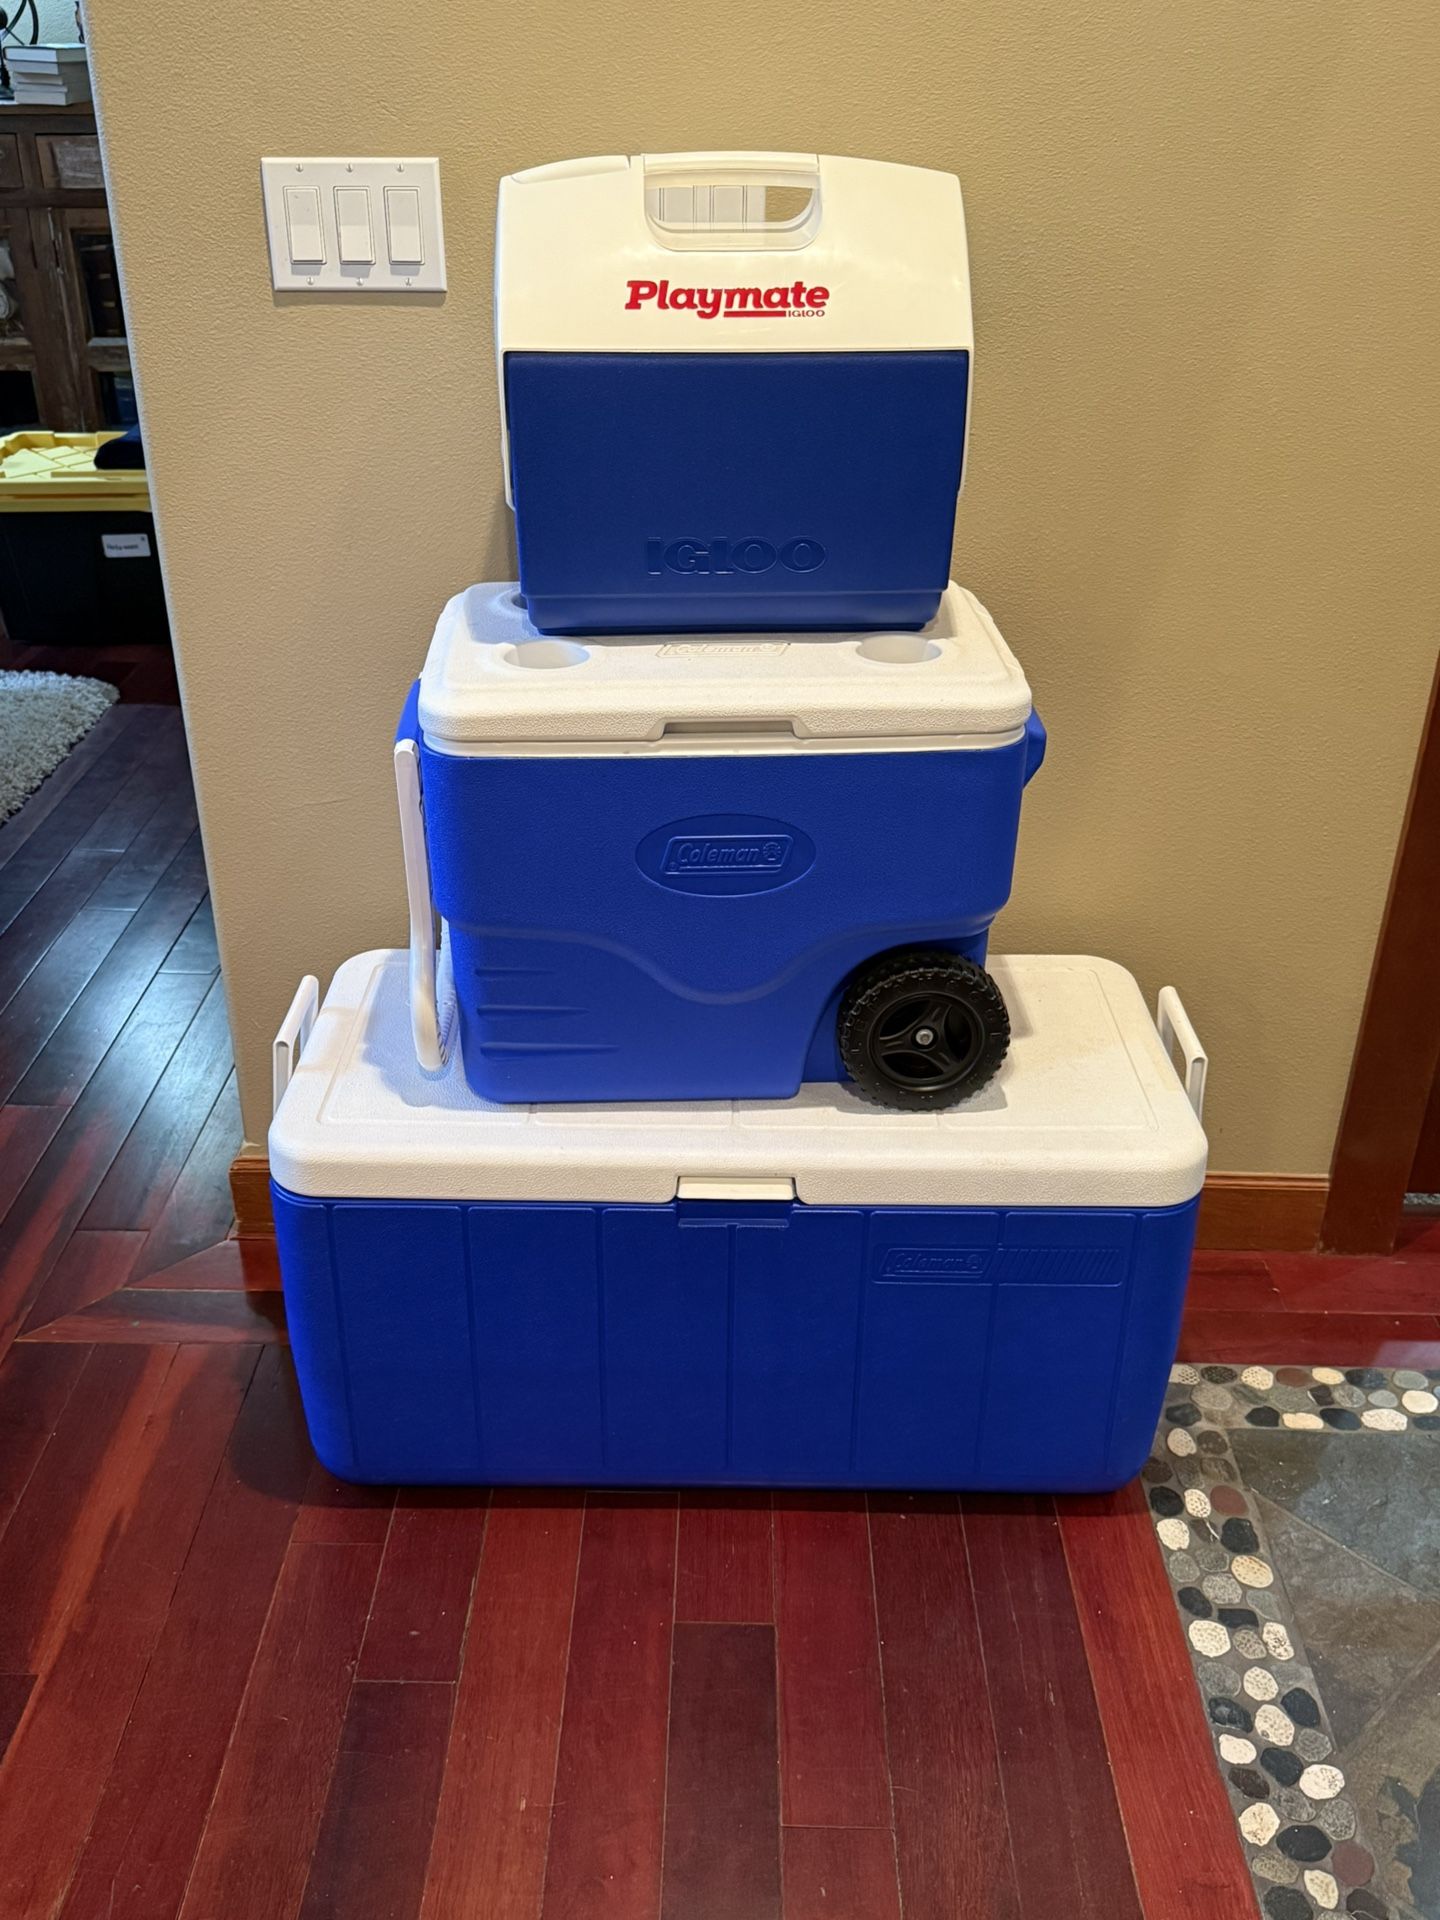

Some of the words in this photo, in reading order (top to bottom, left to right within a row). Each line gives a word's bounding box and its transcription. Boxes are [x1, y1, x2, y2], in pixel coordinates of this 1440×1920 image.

[624, 279, 830, 320] Playmate
[788, 310, 826, 318] IGLOO
[646, 536, 827, 574] IGLOO
[679, 842, 761, 862] Coleman
[896, 1253, 966, 1268] Coleman
